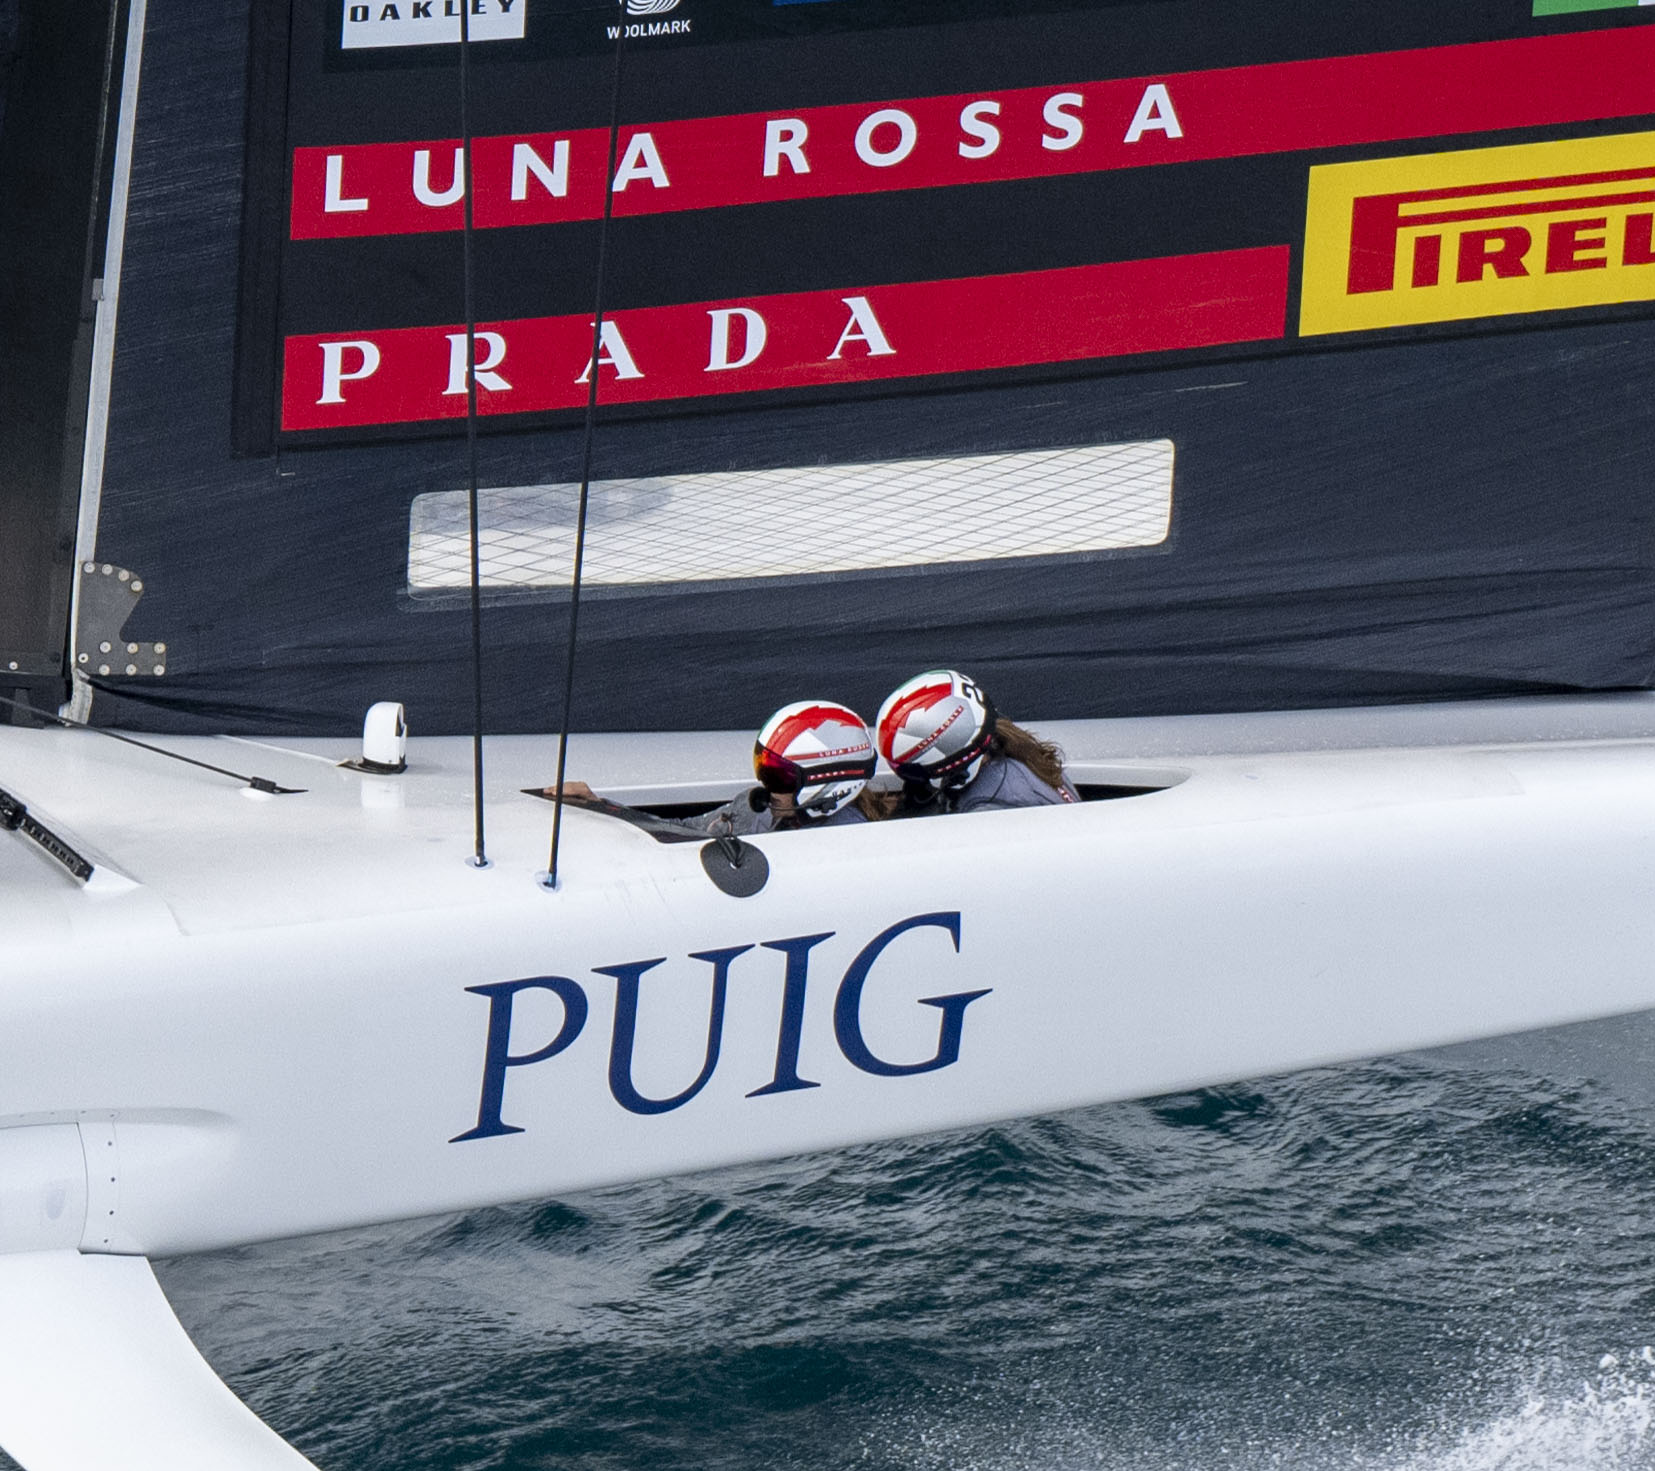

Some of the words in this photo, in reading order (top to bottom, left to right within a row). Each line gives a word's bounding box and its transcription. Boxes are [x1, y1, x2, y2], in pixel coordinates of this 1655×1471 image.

[324, 132, 670, 213] LUNA
[763, 83, 1183, 177] ROSSA
[316, 296, 897, 405] PRADA
[448, 911, 993, 1144] PUIG
